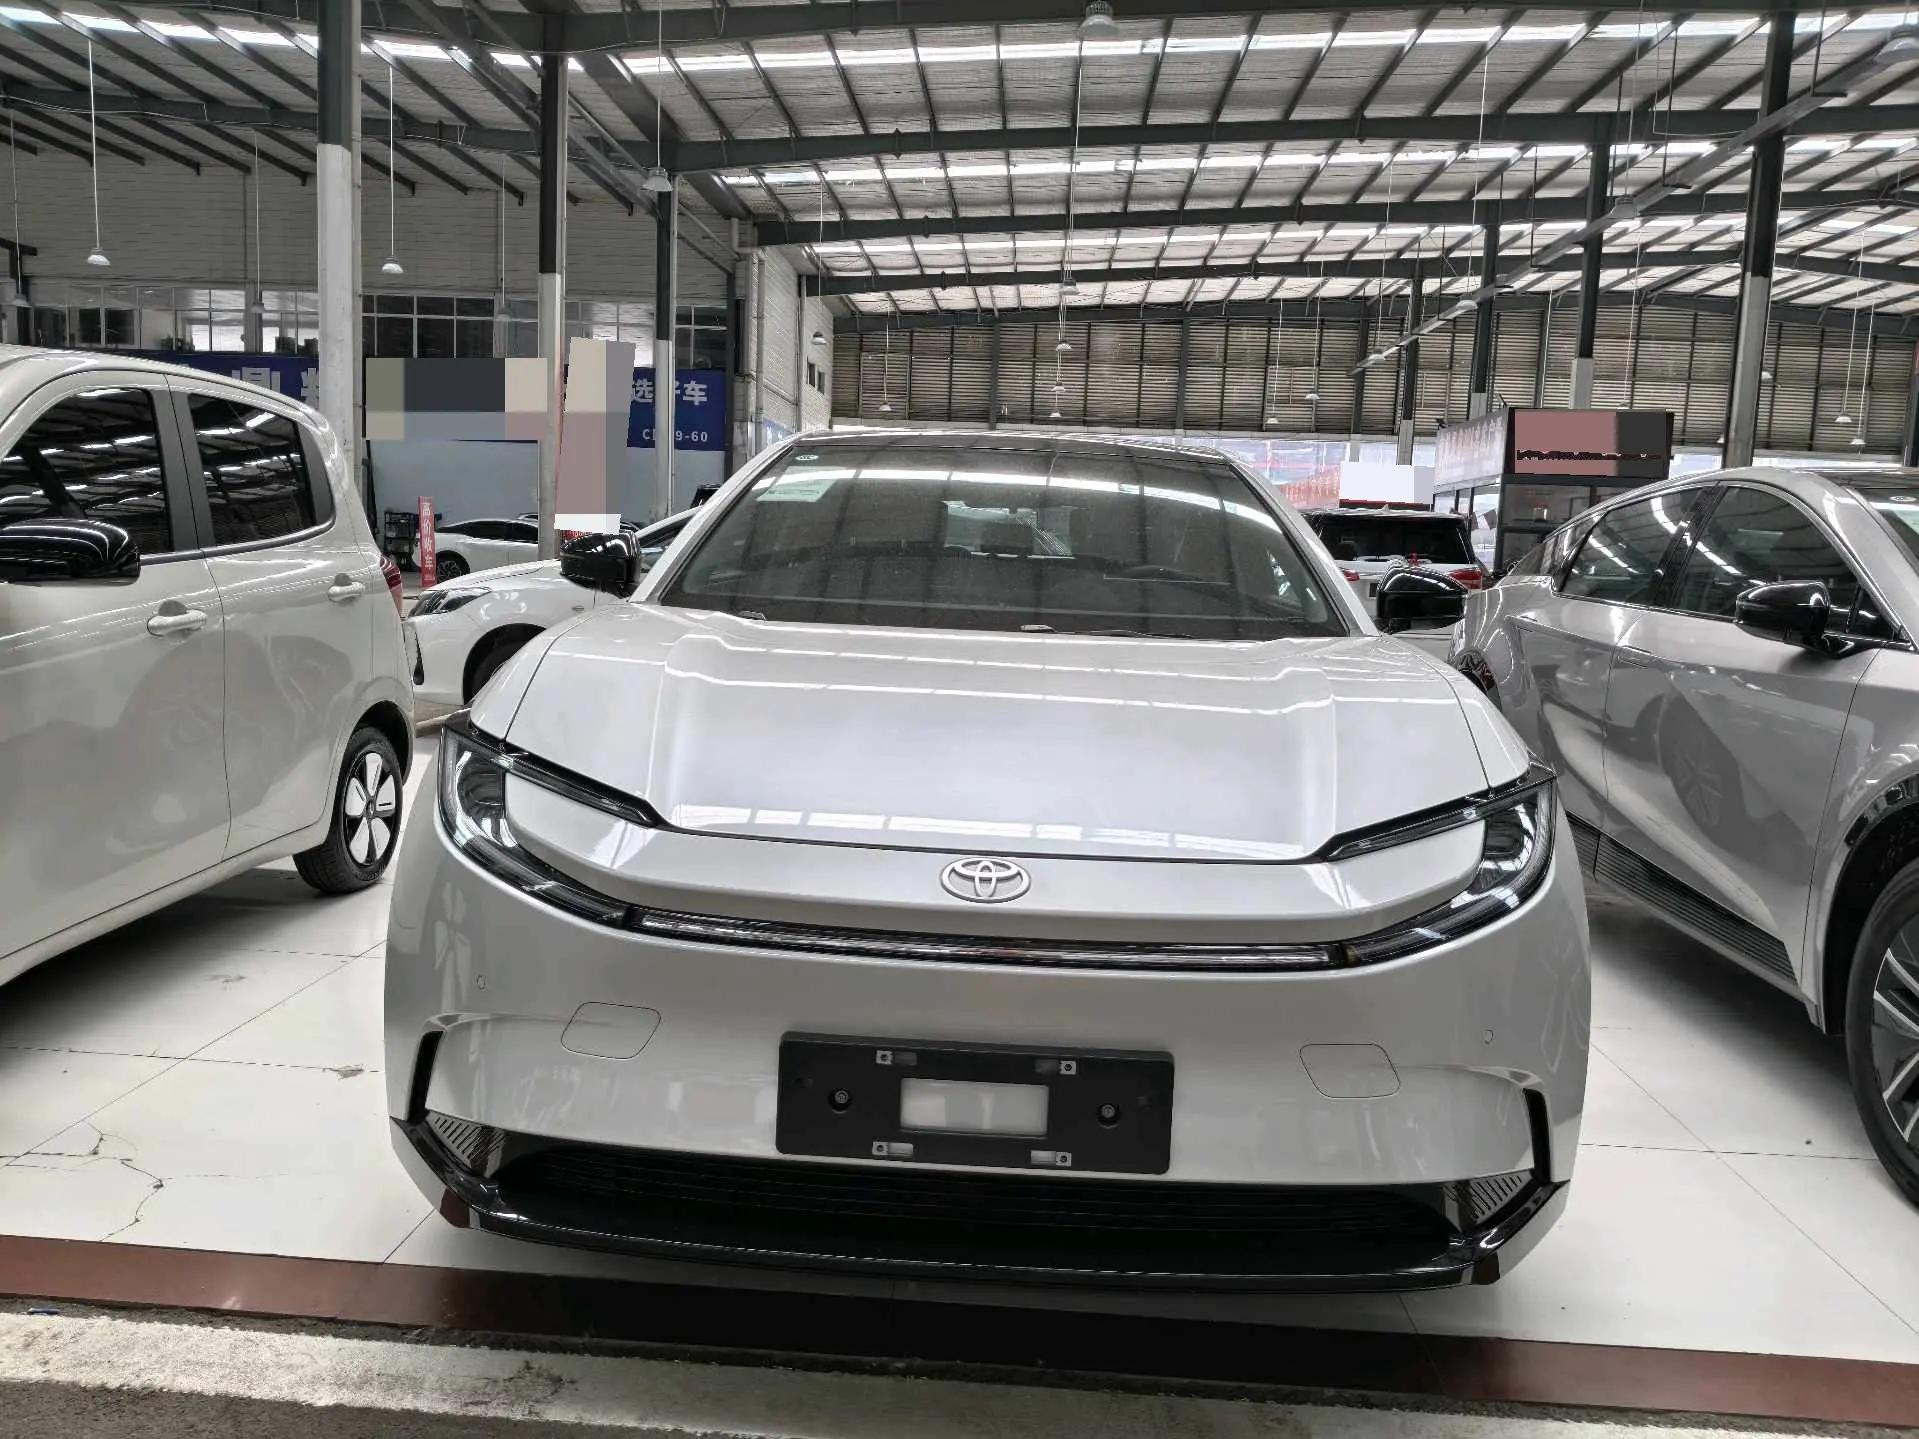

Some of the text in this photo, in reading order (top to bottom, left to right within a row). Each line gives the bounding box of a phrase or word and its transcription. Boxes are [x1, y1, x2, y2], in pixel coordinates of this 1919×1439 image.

[642, 428, 708, 442] C9-60
[422, 502, 434, 570] 高价收车
